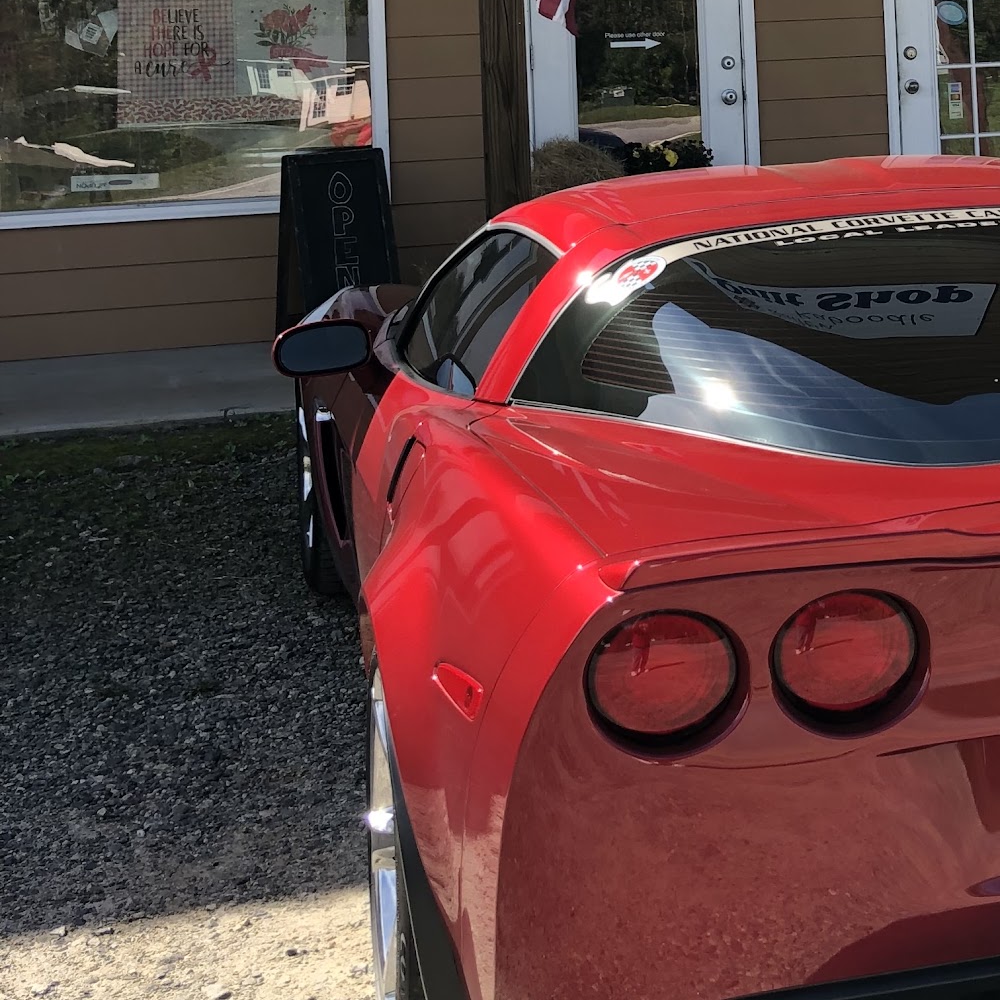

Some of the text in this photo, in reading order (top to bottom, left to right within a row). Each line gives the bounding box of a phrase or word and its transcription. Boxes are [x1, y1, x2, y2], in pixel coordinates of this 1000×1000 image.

[152, 8, 200, 24] BELIEVE
[151, 24, 205, 41] THERE IS
[143, 41, 210, 58] HOPE FOR
[693, 224, 823, 250] NATIONAL
[831, 211, 957, 229] CORVETTE
[774, 229, 883, 247] LOCAL
